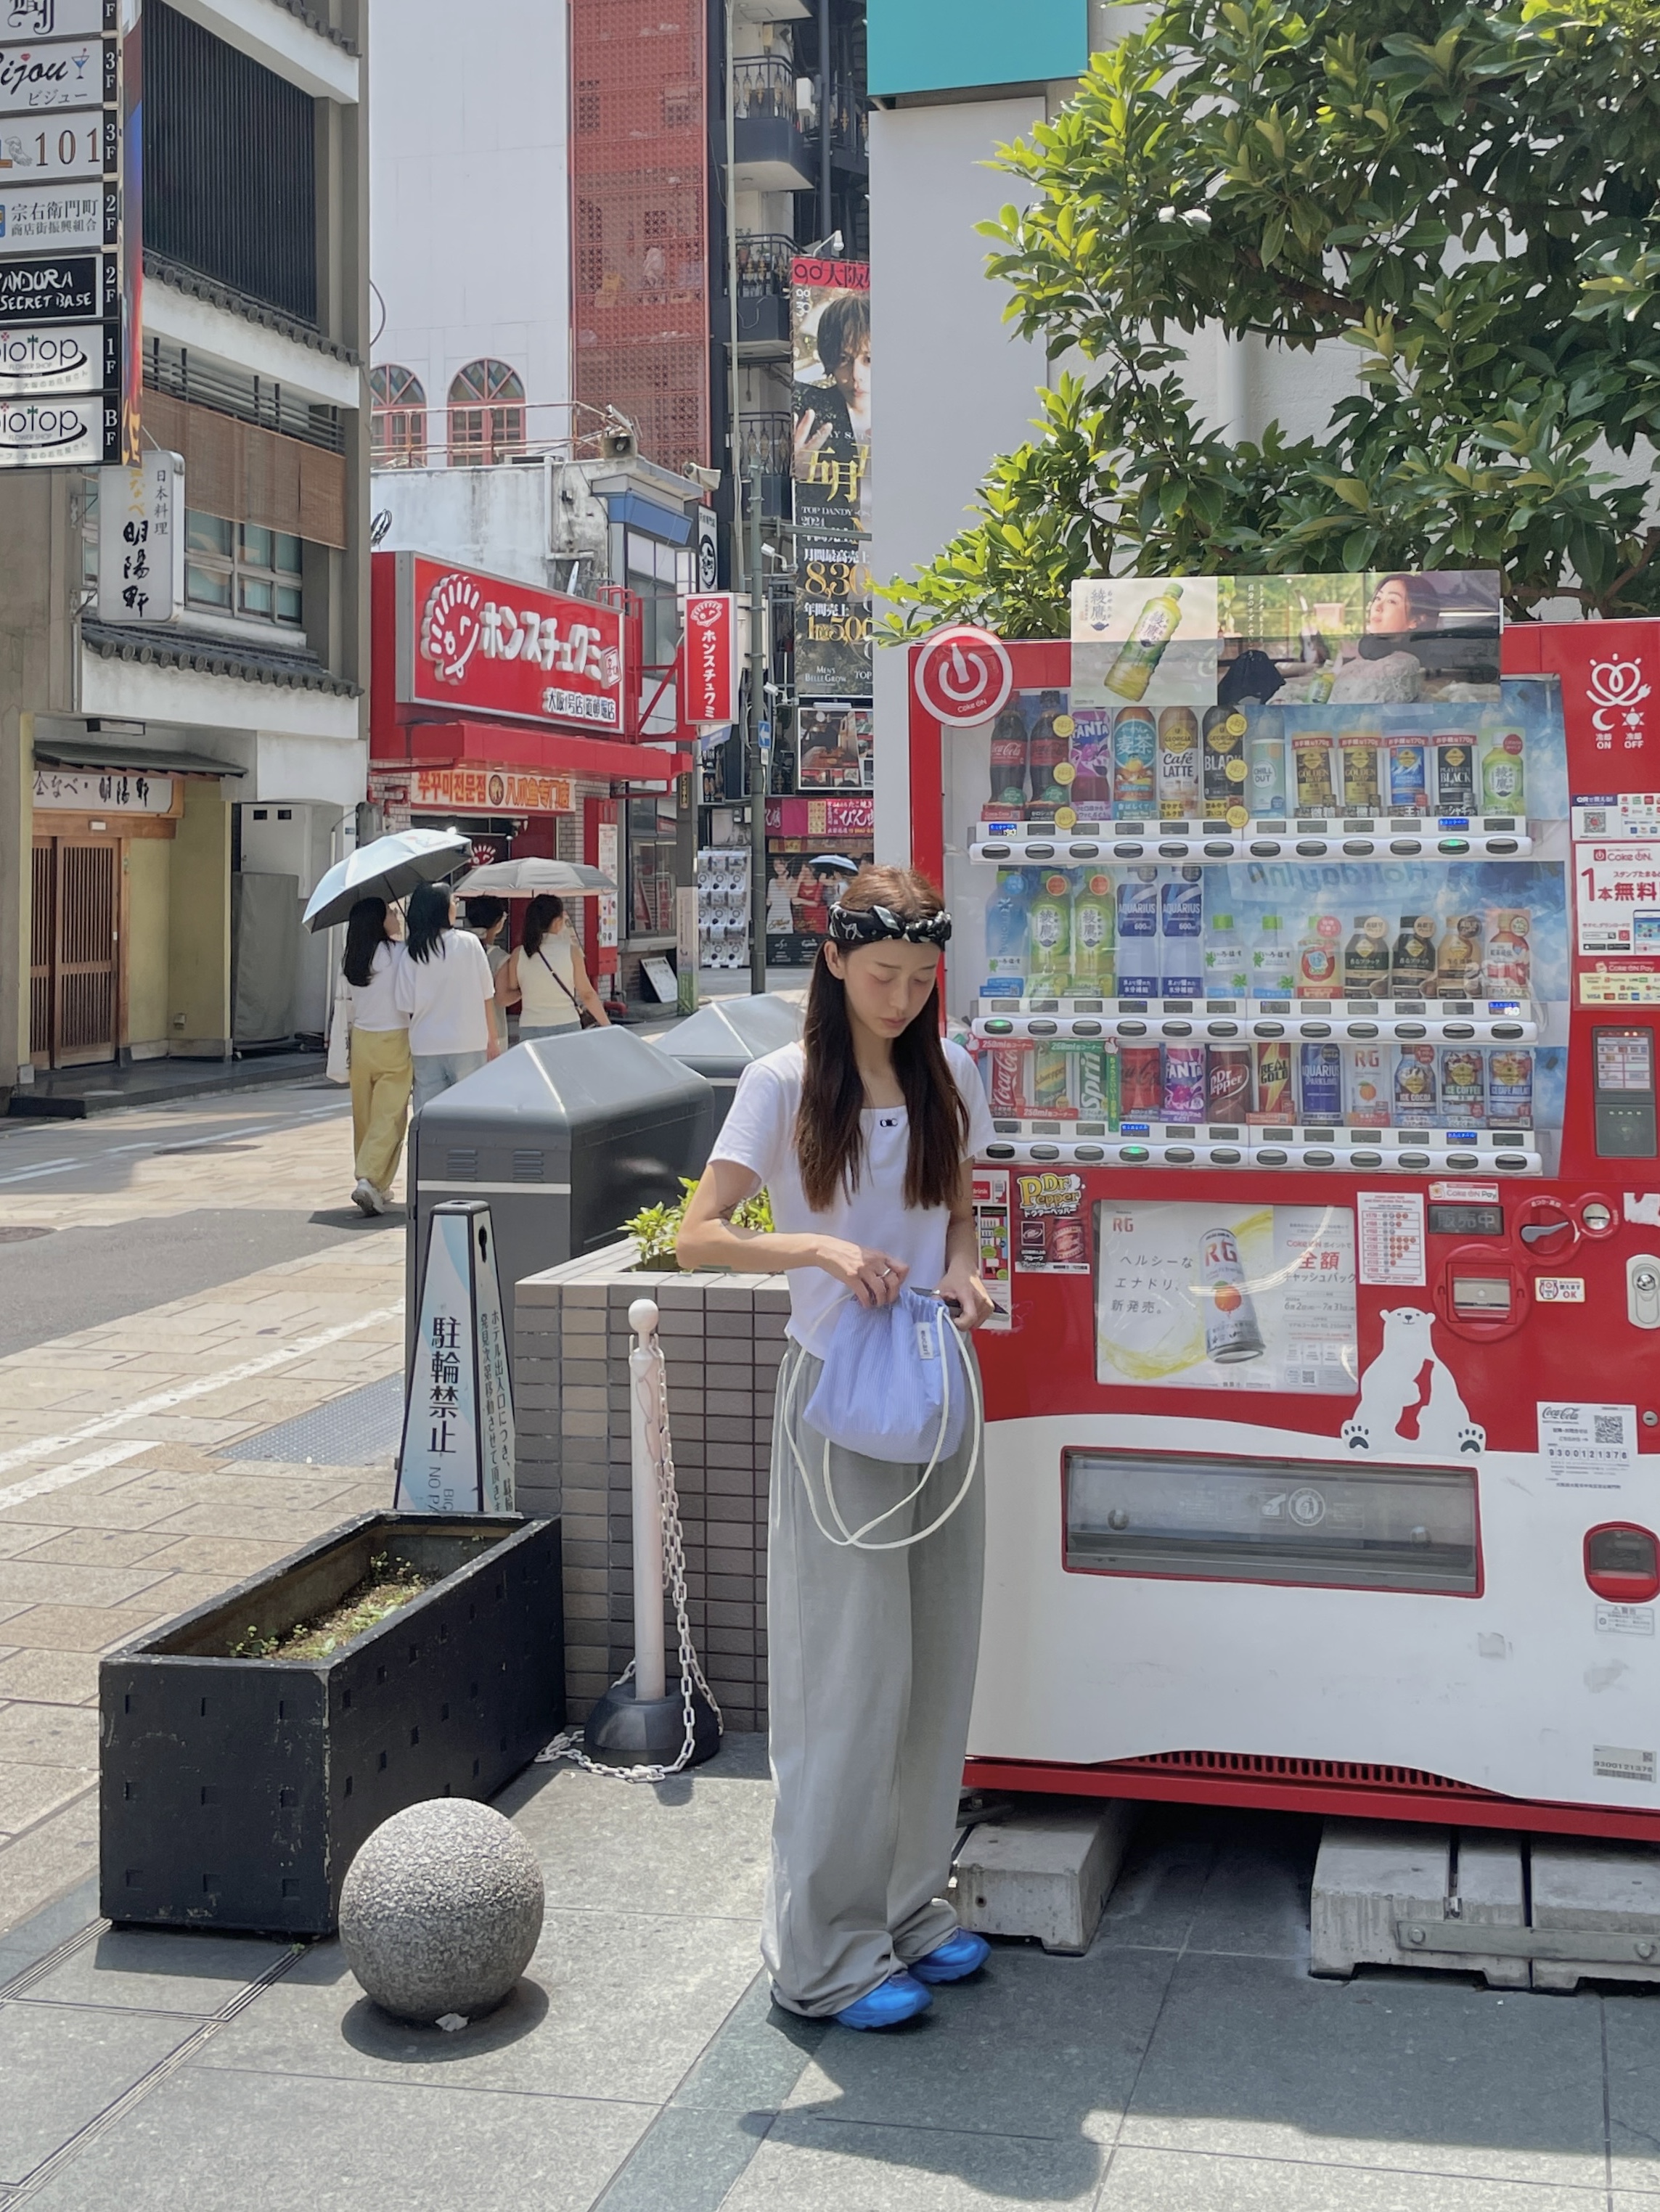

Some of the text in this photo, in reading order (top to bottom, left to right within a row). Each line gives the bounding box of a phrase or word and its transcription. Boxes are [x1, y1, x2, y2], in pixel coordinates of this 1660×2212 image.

[28, 91, 88, 107] ビジュー
[11, 199, 99, 222] 宗右衛門町
[11, 218, 97, 237] 商店街振興組合
[1, 292, 91, 311] SECRET BASE
[0, 335, 78, 366] iotop
[0, 406, 78, 437] iotop
[154, 470, 168, 536] 日本料理
[480, 602, 602, 681] ホンスチュクミ
[701, 629, 717, 719] ホンスチュクミ
[1116, 733, 1154, 755] 麦茶
[1624, 740, 1644, 749] OFF
[1164, 752, 1193, 765] Café
[1204, 755, 1242, 771] BLA
[1163, 765, 1194, 778] LATTE
[1440, 771, 1471, 784] BLACK
[1608, 852, 1634, 861] Coke
[1119, 903, 1156, 914] AQUARIUS
[1163, 903, 1200, 914] AQUARIUS
[1354, 1050, 1379, 1068] RG
[1261, 1060, 1287, 1075] REAL
[1217, 1070, 1232, 1084] Dr
[1261, 1069, 1288, 1084] GOLD
[1042, 1173, 1069, 1192] Dr
[1018, 1176, 1079, 1208] Pepper
[1024, 1207, 1076, 1218] ドクターペッパー
[1436, 1212, 1495, 1229] 販売中
[1113, 1217, 1134, 1233] RG
[1205, 1240, 1238, 1266] RG
[1298, 1251, 1341, 1270] 全額
[1120, 1254, 1194, 1269] ヘルシーな
[1115, 1277, 1180, 1292] エナドリ、
[1111, 1299, 1164, 1315] 新発売。
[427, 1316, 462, 1454] 駐輪禁止
